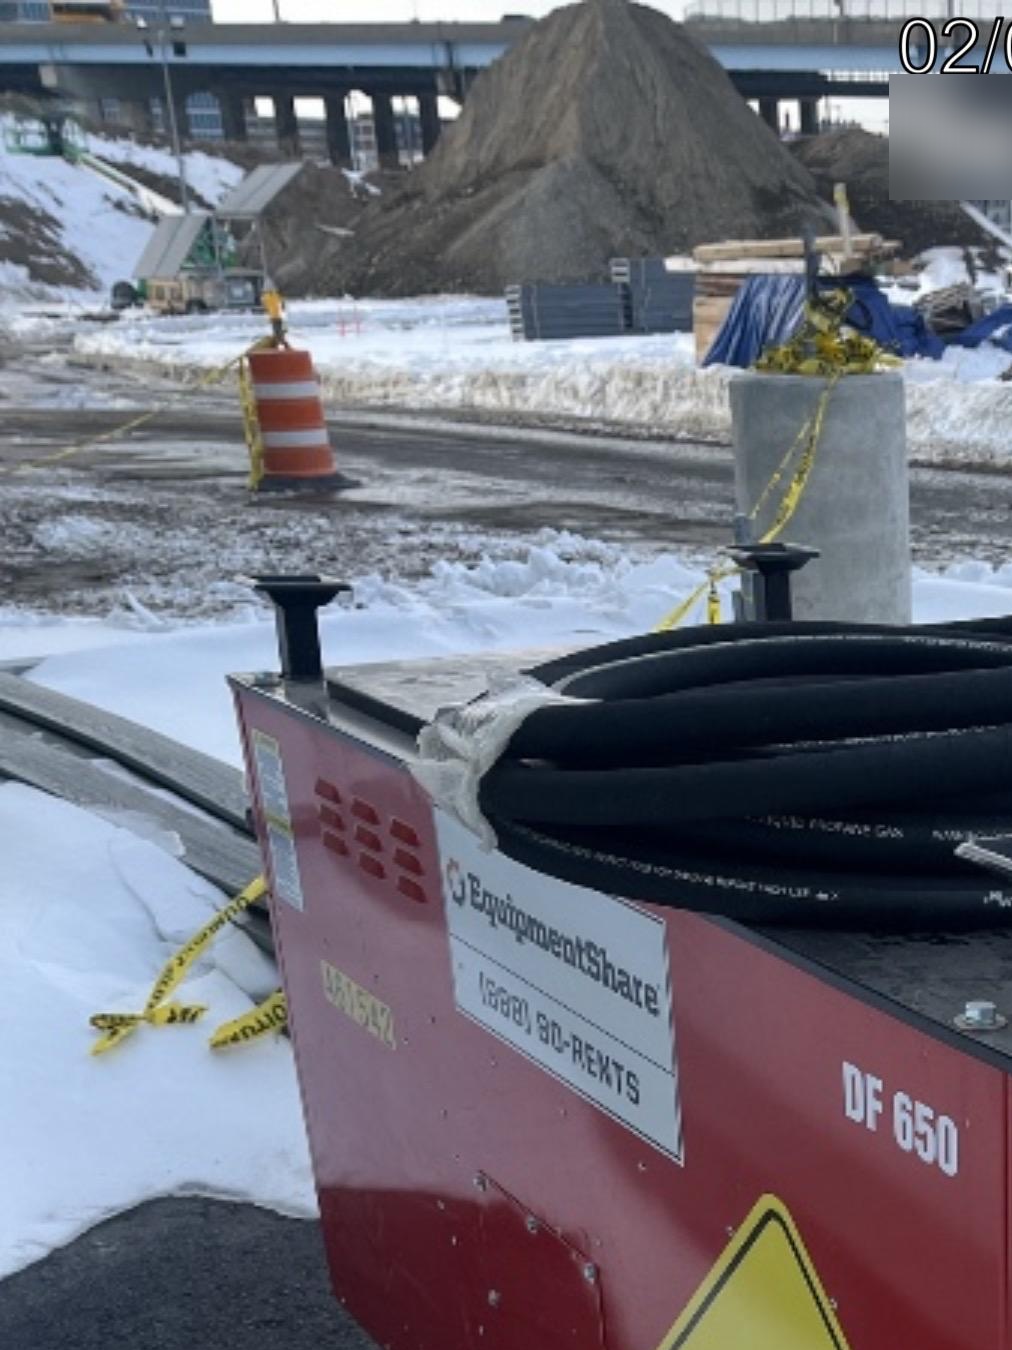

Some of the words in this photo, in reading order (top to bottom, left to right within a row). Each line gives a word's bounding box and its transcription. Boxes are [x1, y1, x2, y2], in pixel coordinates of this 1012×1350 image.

[467, 872, 662, 1018] EquipmentShare
[842, 1060, 884, 1132] DF
[892, 1091, 958, 1177] 650
